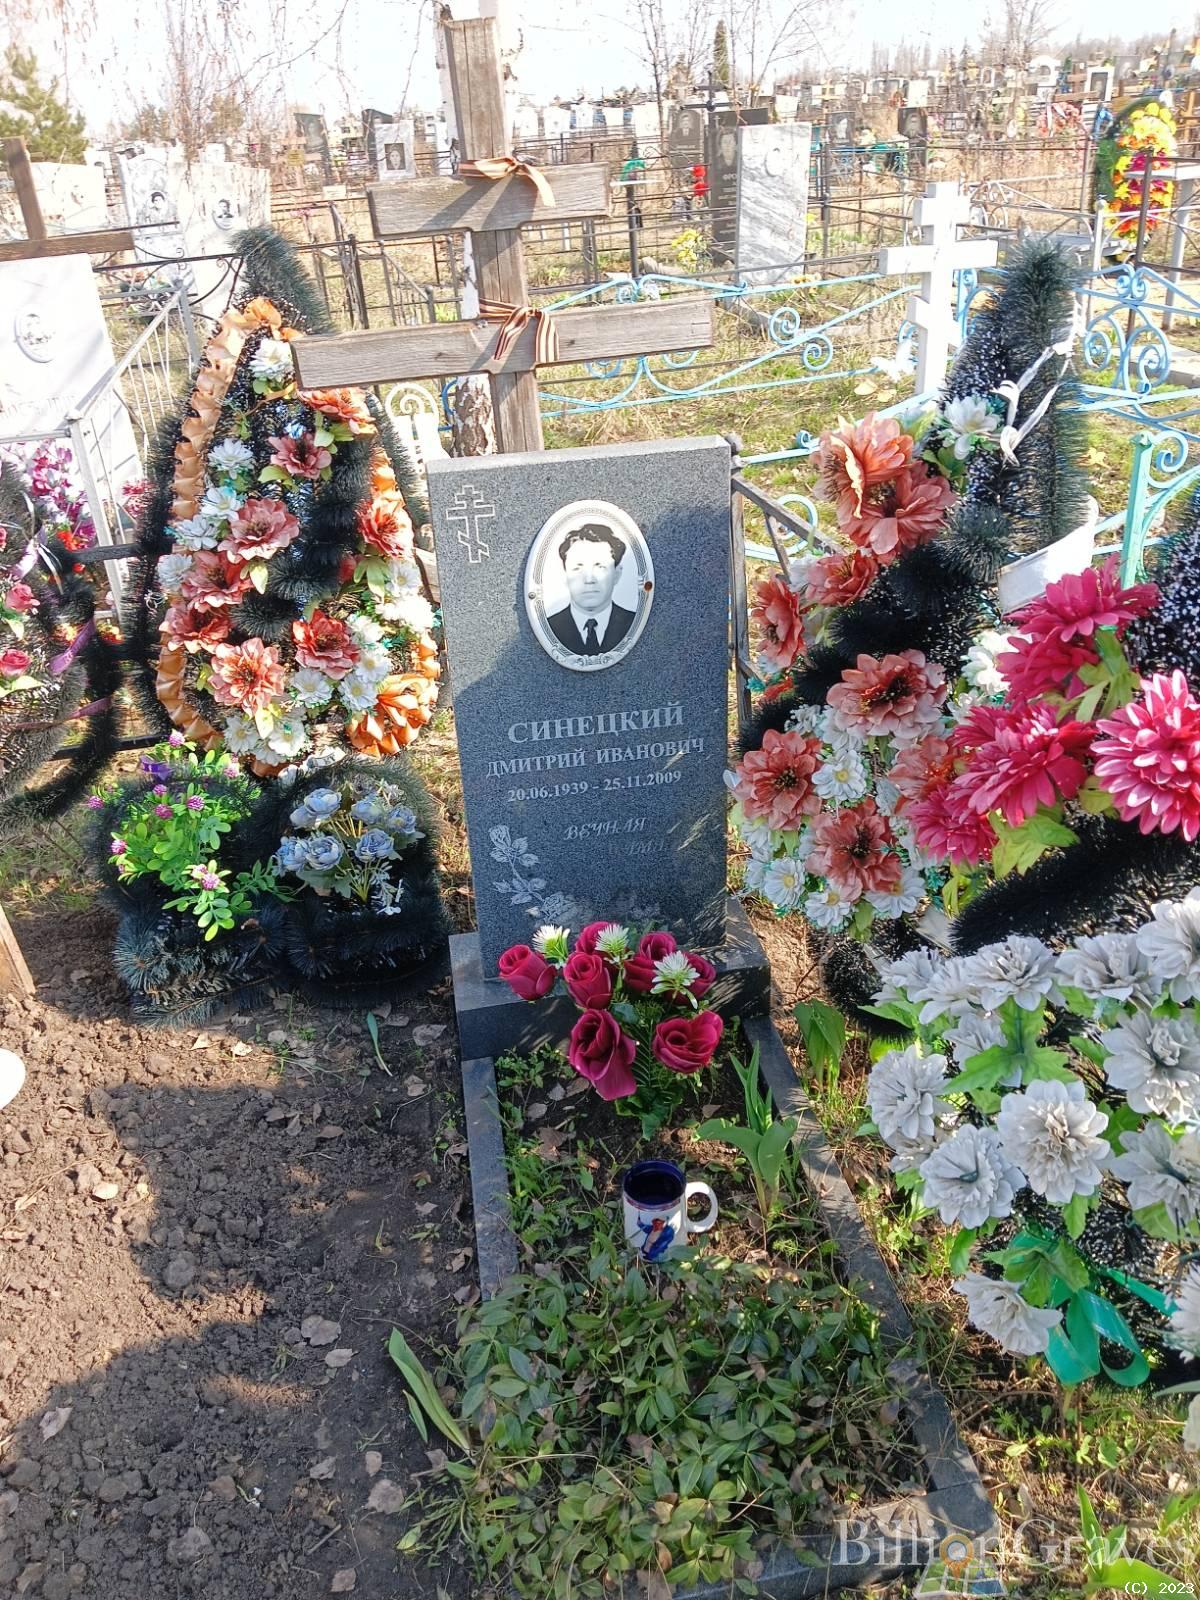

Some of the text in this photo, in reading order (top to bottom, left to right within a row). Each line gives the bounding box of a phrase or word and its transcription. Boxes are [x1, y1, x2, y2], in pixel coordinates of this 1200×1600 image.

[507, 701, 686, 744] СИНЕЦКИЙ
[486, 737, 705, 778] ДМИТРИЙ ИВАНОВИЧ
[507, 780, 589, 802] 20.06.1939
[603, 770, 682, 792] 25.11.2009
